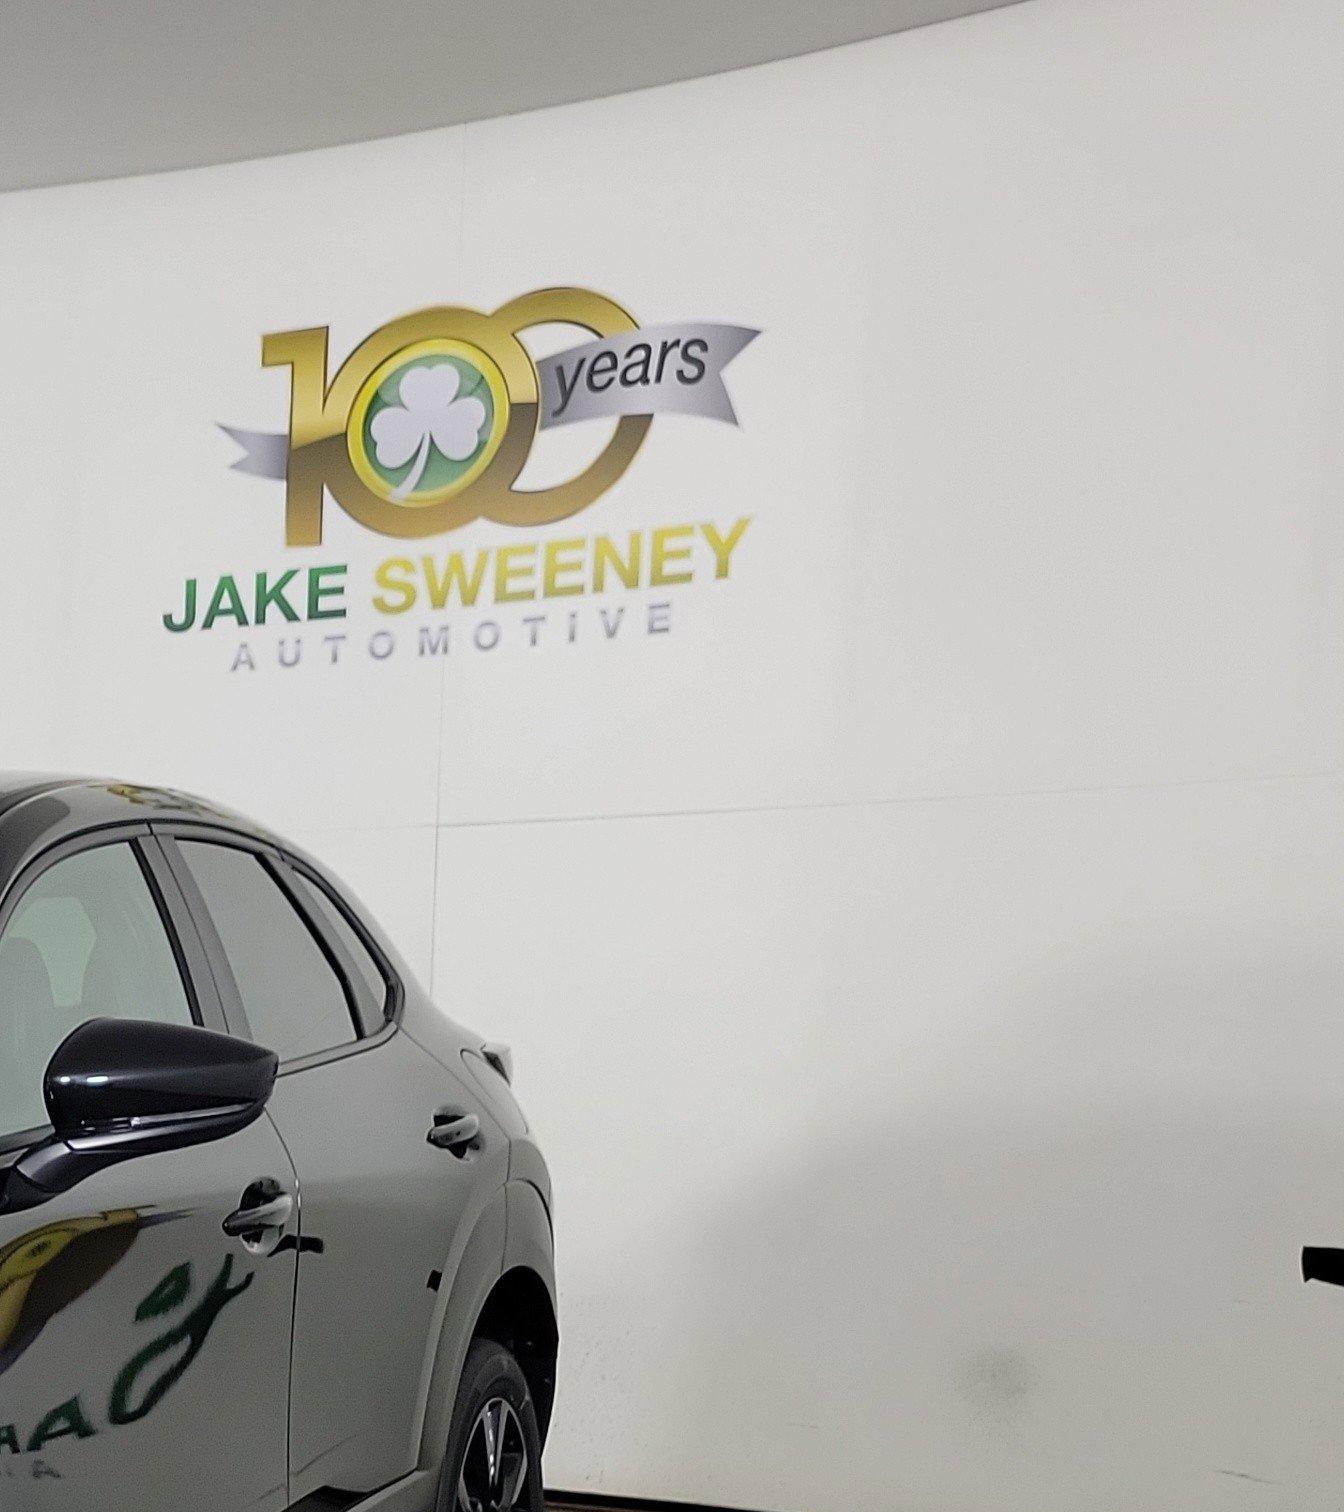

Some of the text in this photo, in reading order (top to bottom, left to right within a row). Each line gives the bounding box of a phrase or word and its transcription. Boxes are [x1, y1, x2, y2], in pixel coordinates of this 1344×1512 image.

[262, 287, 654, 548] 100
[551, 337, 708, 418] years
[162, 516, 753, 633] JAKE SWEENEY
[230, 603, 673, 672] AUTOMOTIVE
